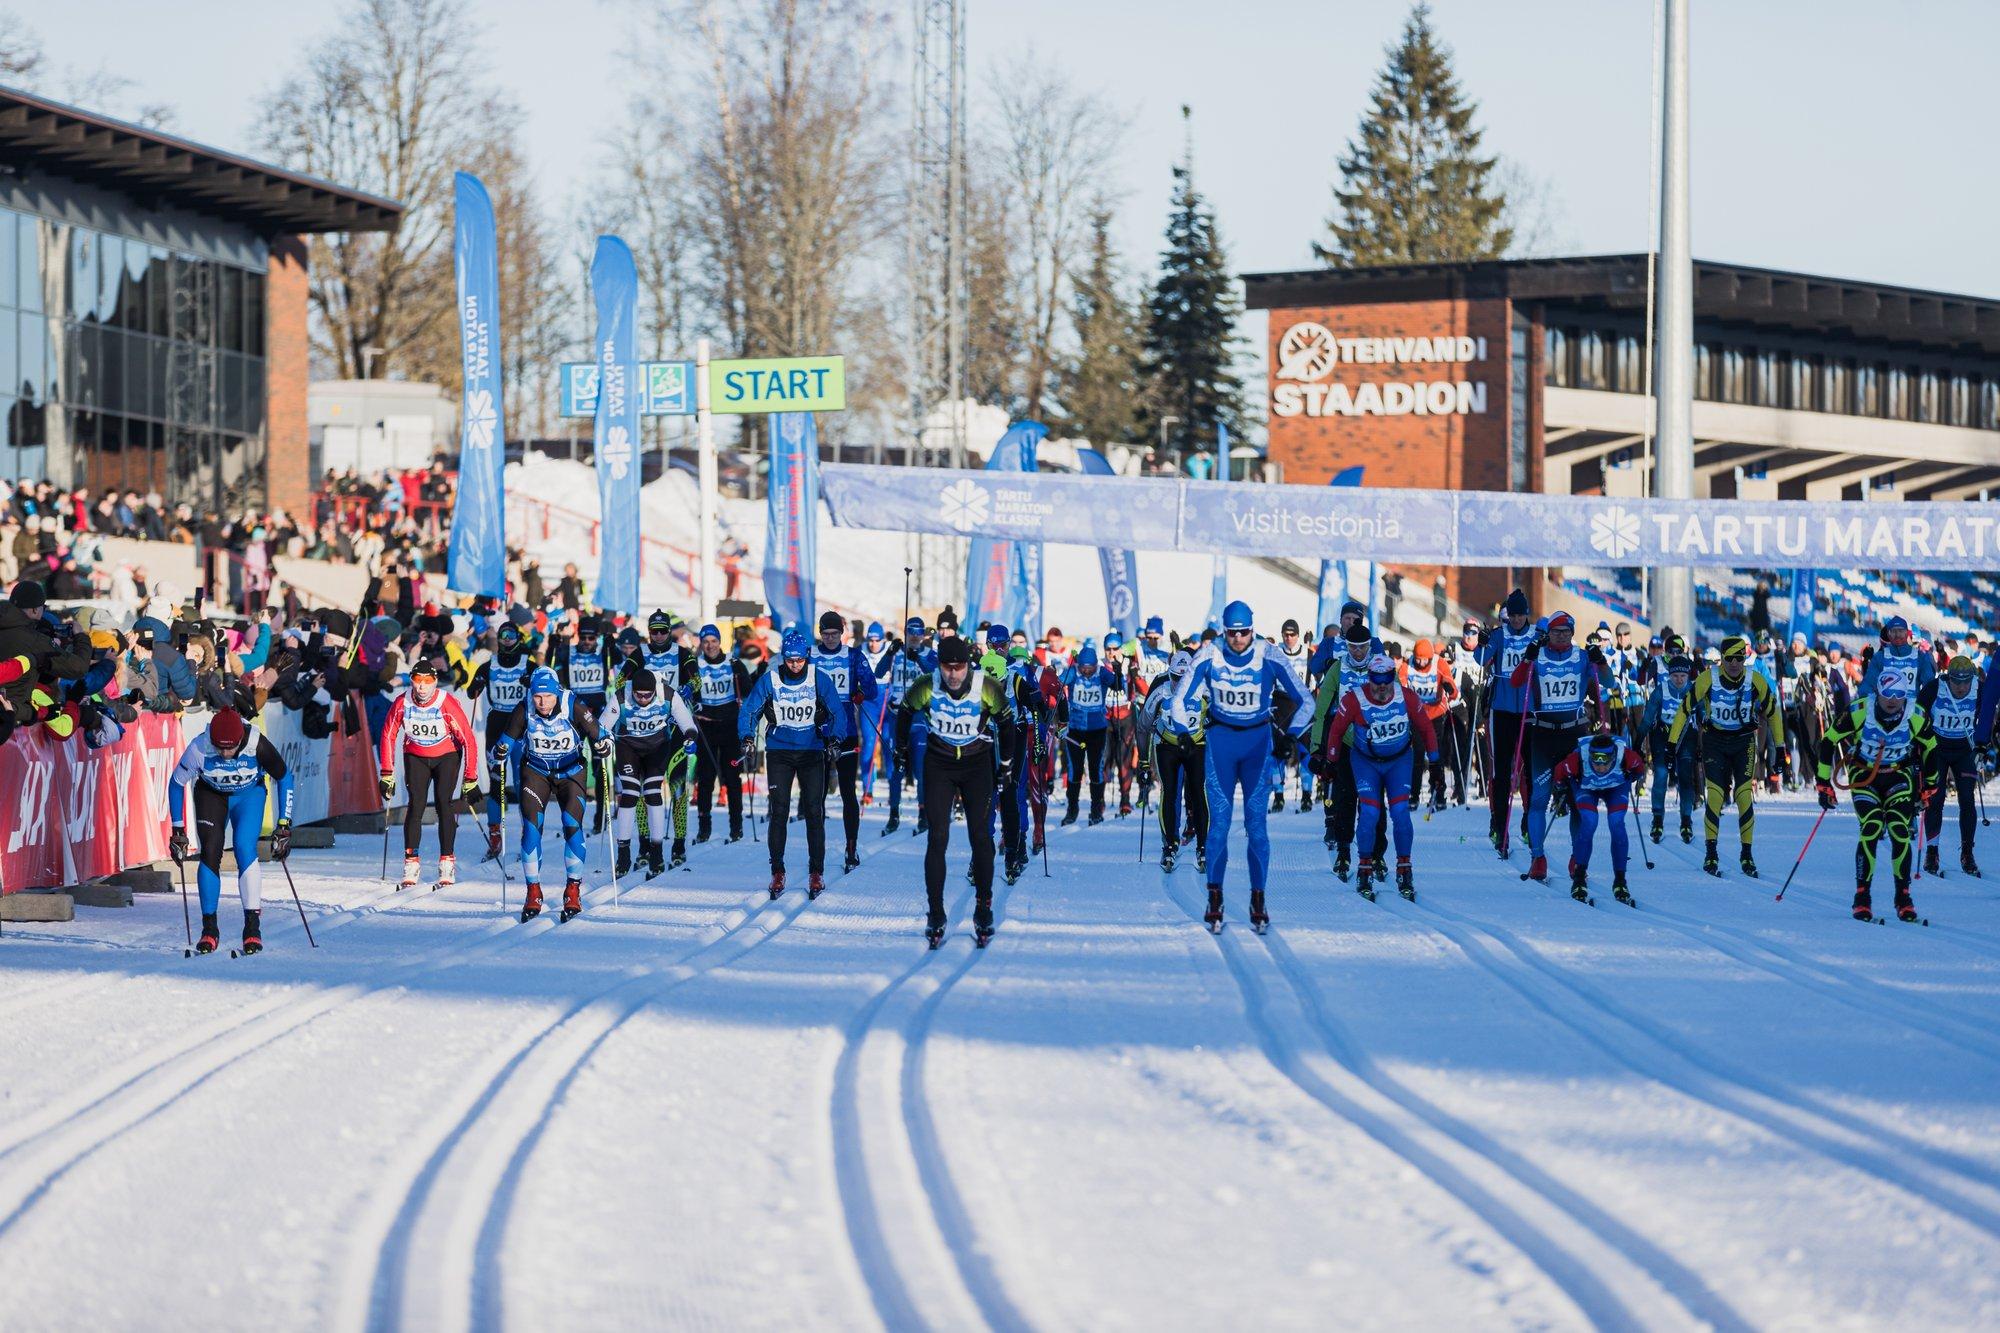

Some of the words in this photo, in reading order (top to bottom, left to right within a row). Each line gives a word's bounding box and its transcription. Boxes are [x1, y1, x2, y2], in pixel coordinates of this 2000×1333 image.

[1336, 336, 1488, 364] TEHVANDI
[725, 368, 830, 401] START
[1273, 380, 1488, 417] STAADION
[995, 489, 1033, 502] TARTU
[992, 514, 1042, 526] KLASSIK
[1231, 506, 1292, 535] visit
[1296, 510, 1401, 539] estonia
[1653, 515, 1807, 556] TARTU
[1825, 516, 2000, 558] MARAT
[573, 669, 601, 683] 1022
[496, 685, 524, 700] 1128
[704, 680, 731, 695] 1407
[1545, 681, 1577, 698] 1473
[1219, 689, 1255, 707] 1031
[780, 705, 814, 722] 1099
[1715, 707, 1748, 722] 1003
[412, 724, 439, 737] 894
[1374, 722, 1406, 738] 1450
